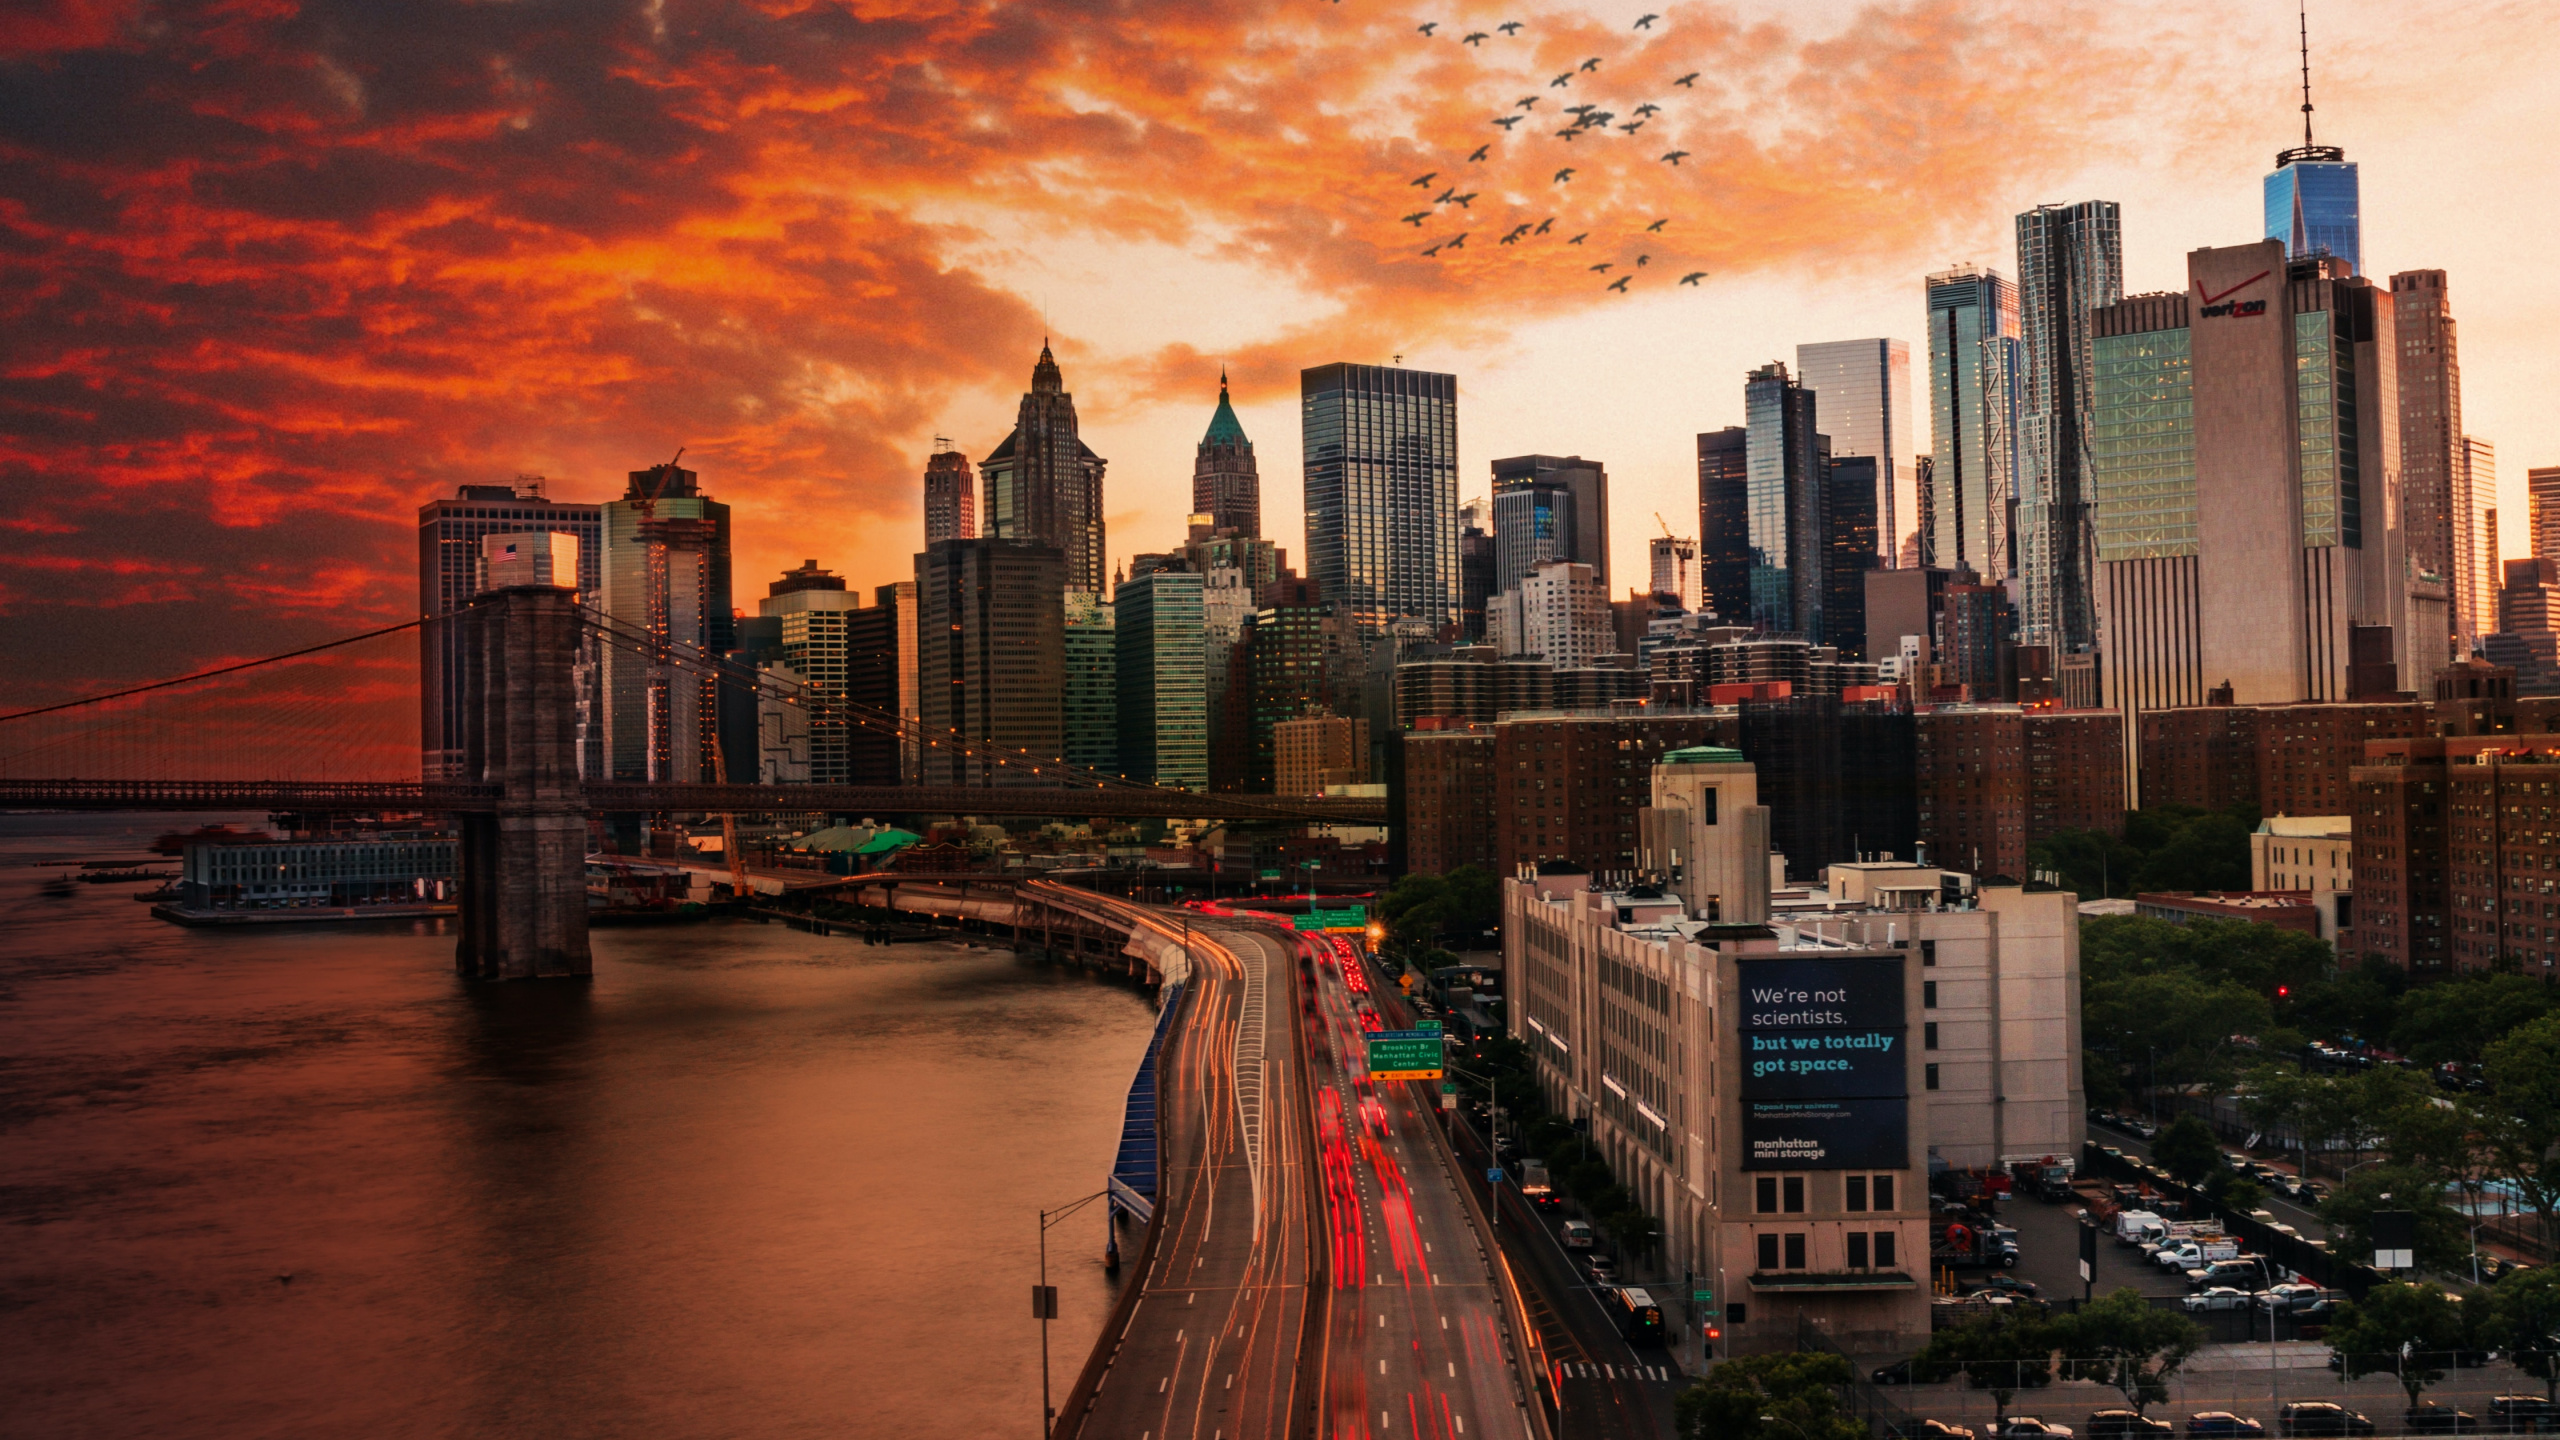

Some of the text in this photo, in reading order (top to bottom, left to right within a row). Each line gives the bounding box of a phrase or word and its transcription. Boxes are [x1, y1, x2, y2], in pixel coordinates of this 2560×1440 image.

[2200, 299, 2267, 318] verizon
[1752, 988, 1847, 1004] We're not
[1752, 1009, 1848, 1026] scientists,
[1382, 1044, 1417, 1052] Brooklyn
[1752, 1033, 1894, 1052] but we totally
[1753, 1058, 1854, 1078] got space.
[1753, 1103, 1784, 1111] Expand
[1753, 1111, 1851, 1119] ManhattanMiniStorage.com
[1754, 1136, 1818, 1149] manhattan
[1754, 1149, 1825, 1160] mini storage
